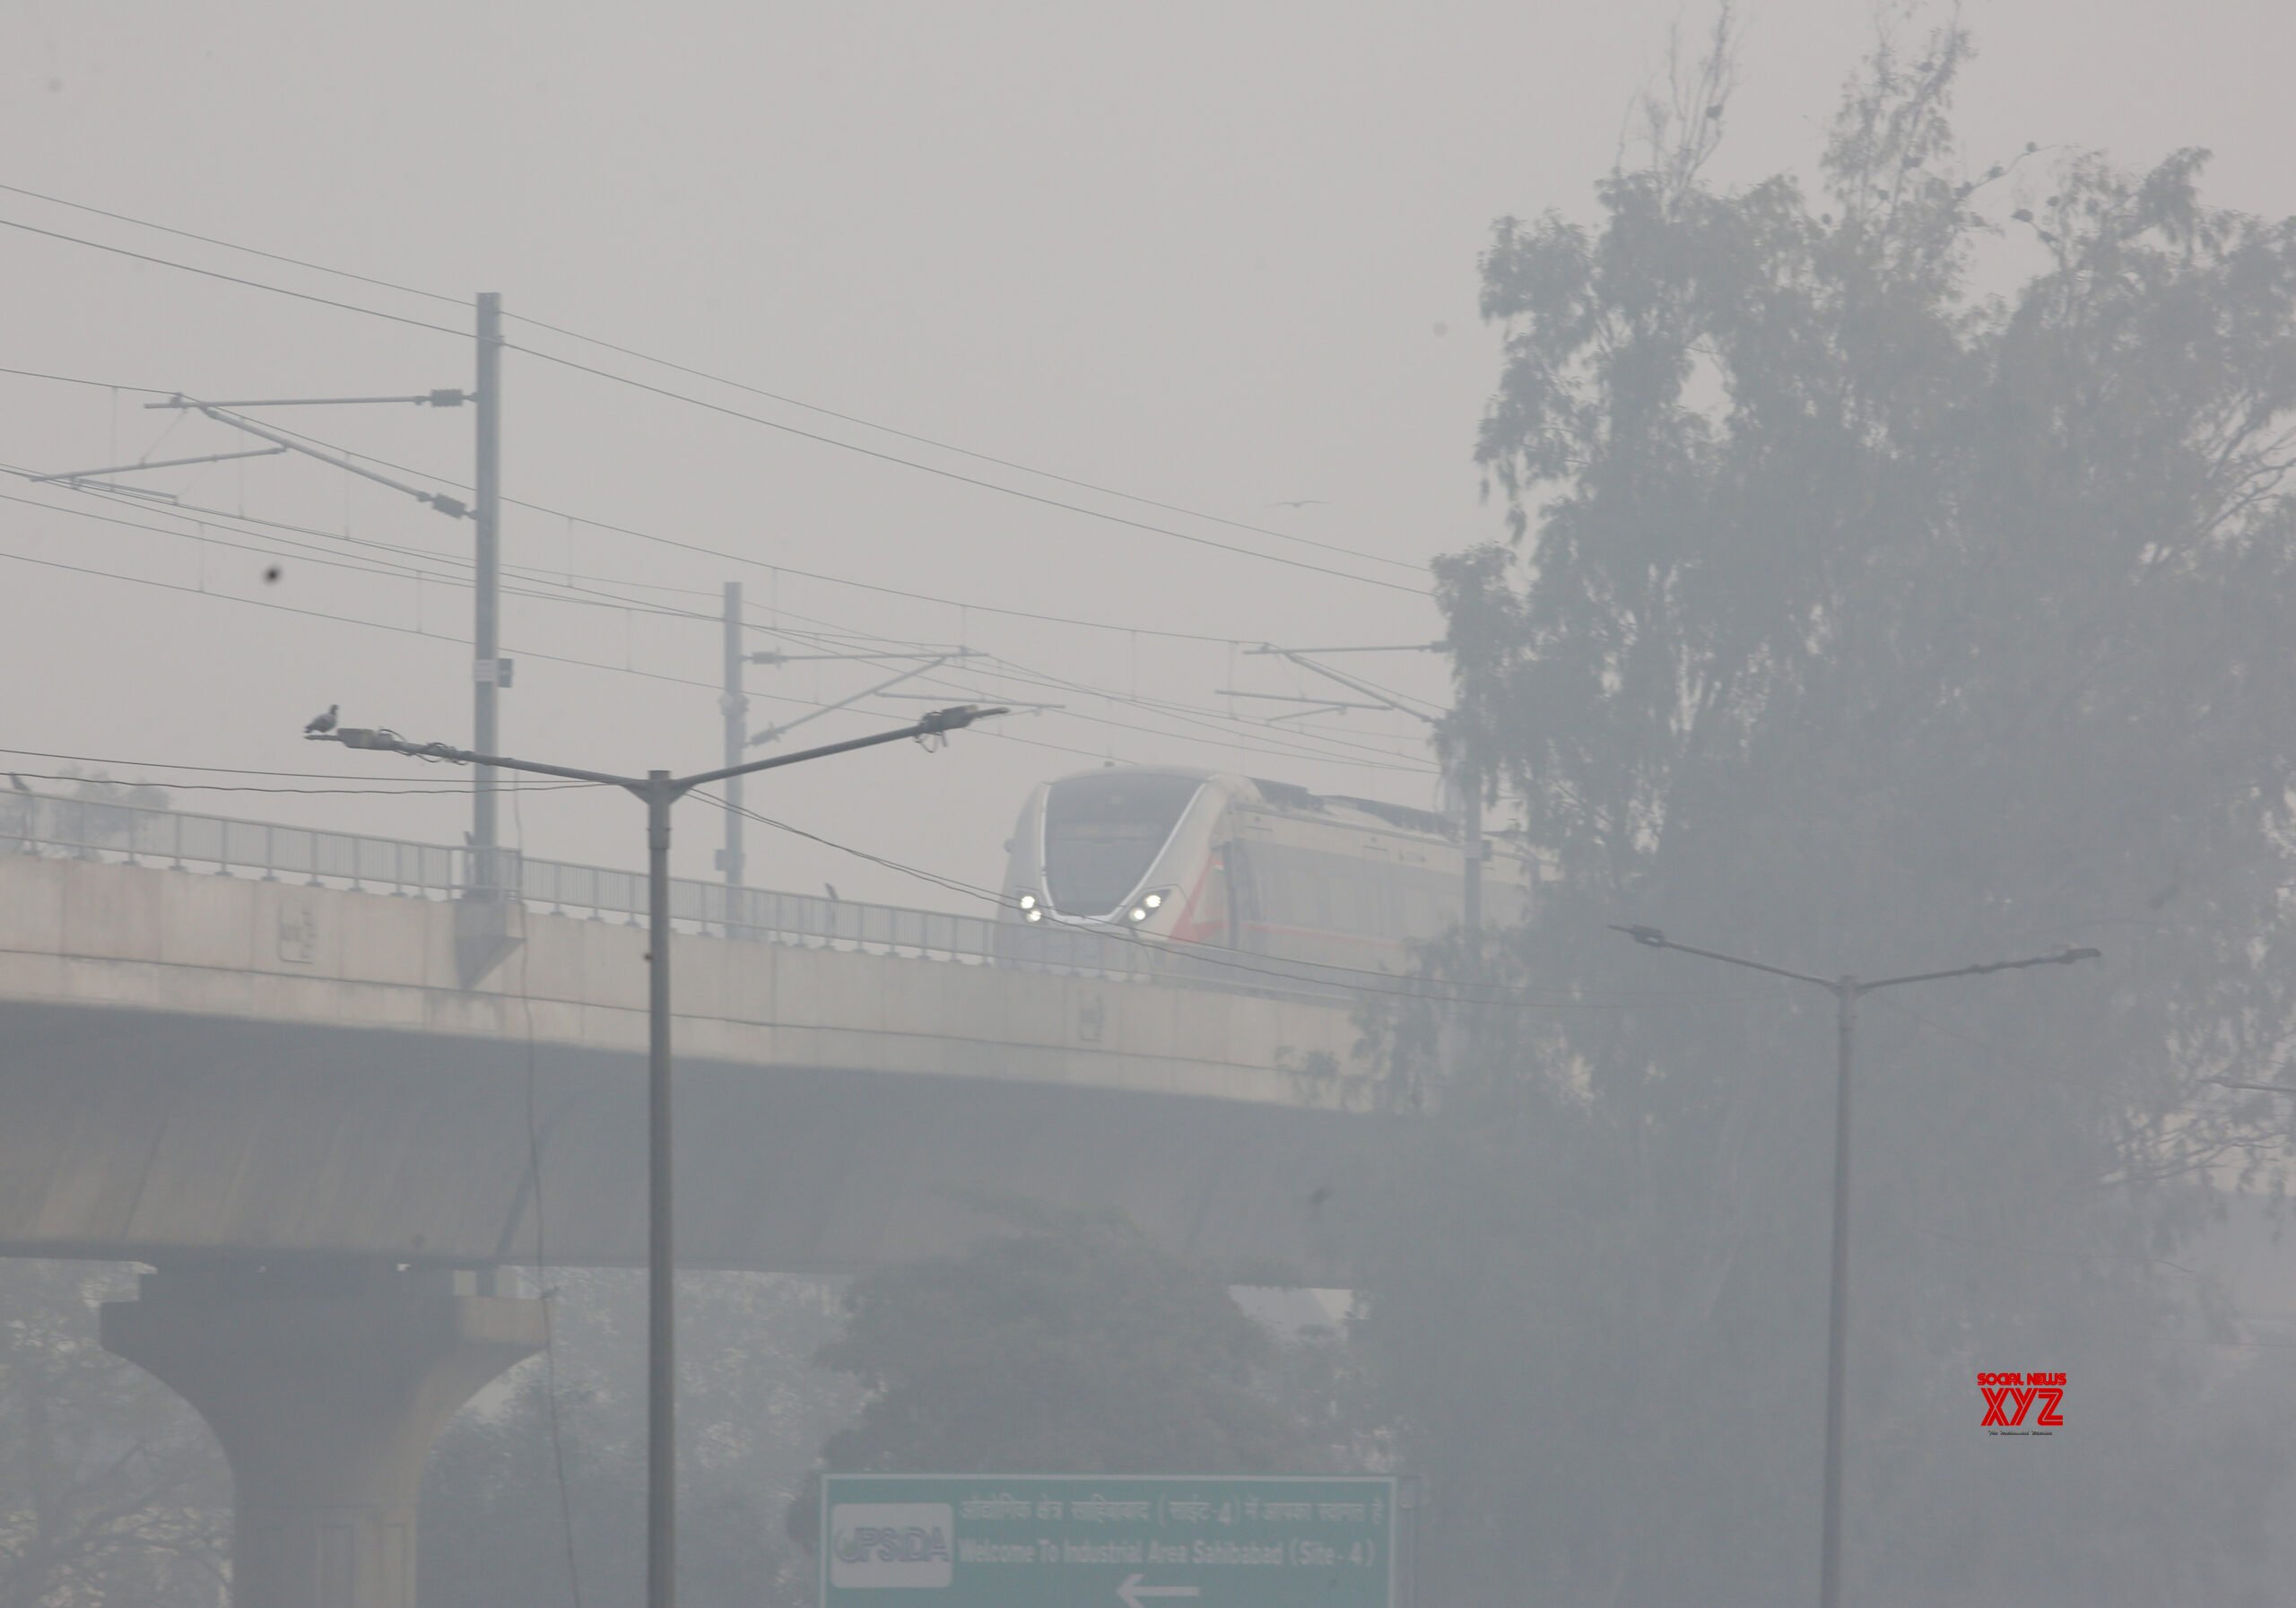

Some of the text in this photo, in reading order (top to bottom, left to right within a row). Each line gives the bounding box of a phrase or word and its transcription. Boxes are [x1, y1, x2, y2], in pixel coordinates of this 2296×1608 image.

[958, 1538, 1034, 1562] Welcome
[1038, 1538, 1058, 1562] To
[1063, 1539, 1144, 1563] Industrial
[1147, 1540, 1188, 1564] Area
[1191, 1540, 1283, 1565] Sahibabad
